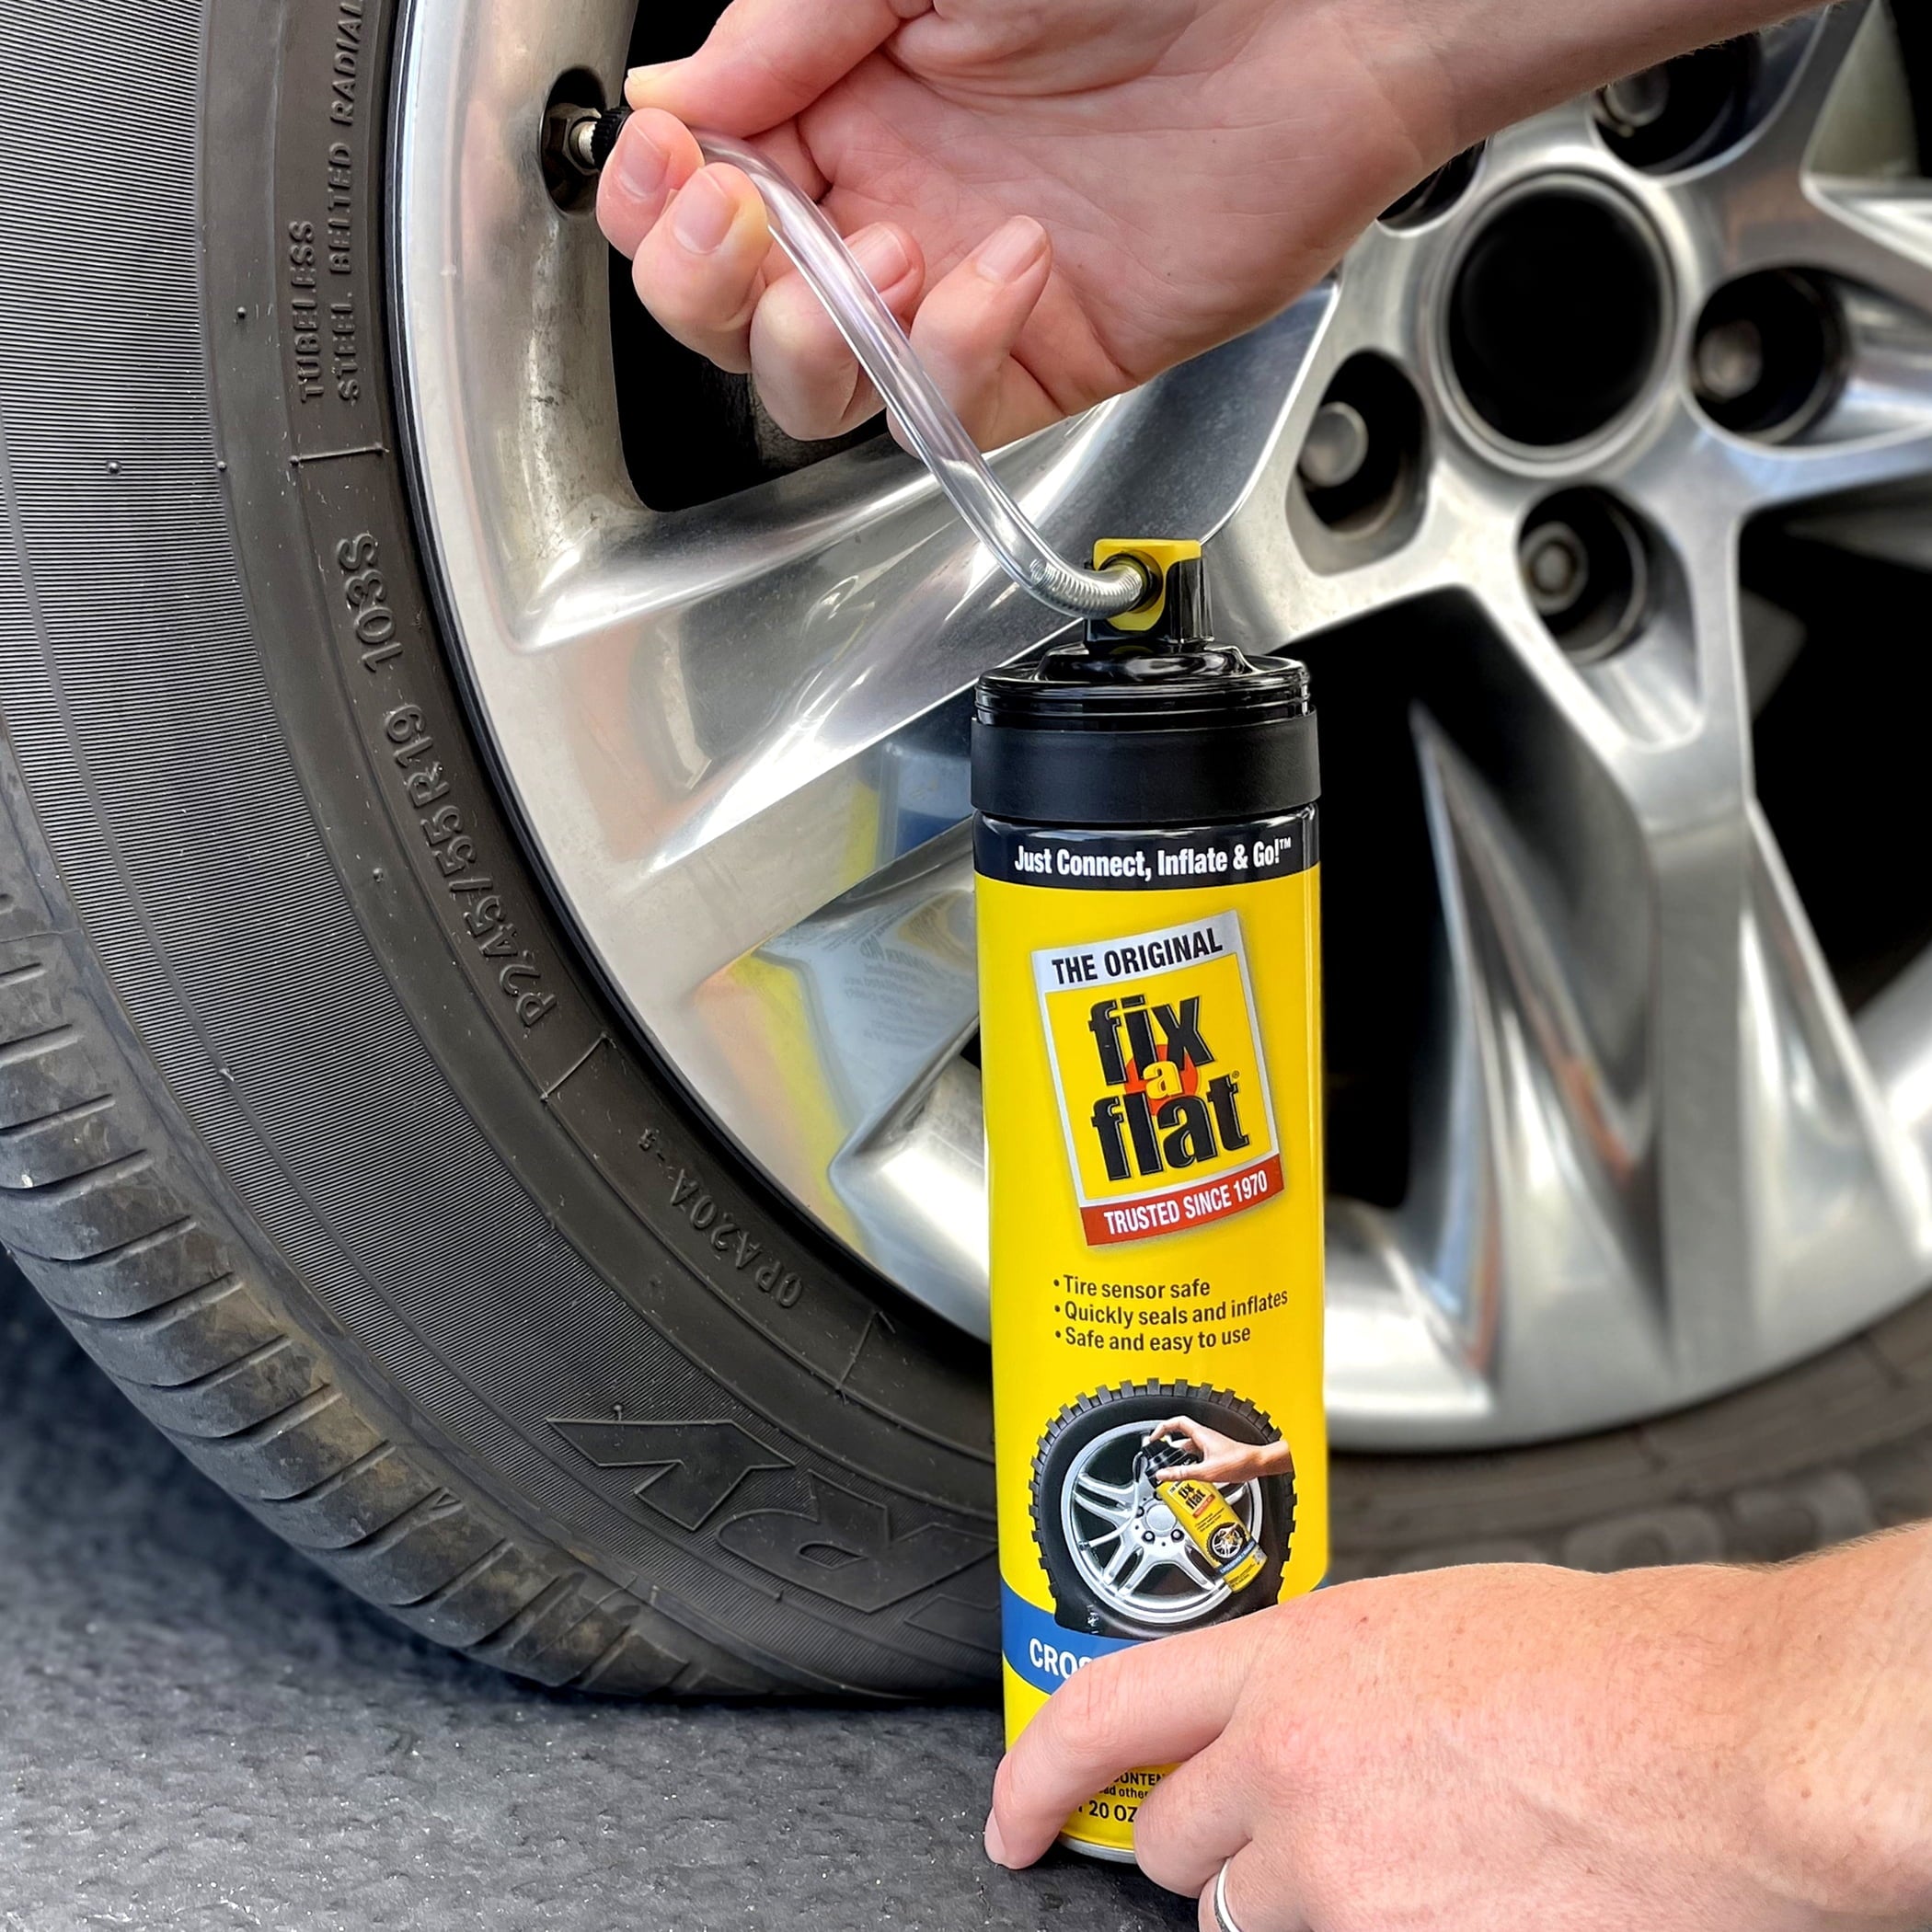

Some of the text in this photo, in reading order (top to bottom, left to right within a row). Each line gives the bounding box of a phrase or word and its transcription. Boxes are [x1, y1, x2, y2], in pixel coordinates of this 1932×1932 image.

[328, 142, 352, 274] BELTED
[289, 221, 324, 403] TUBELESS
[330, 292, 361, 403] STEEL
[1014, 845, 1052, 871] Just
[1056, 848, 1153, 882] Connect,
[1156, 845, 1228, 877] Inflate
[1232, 843, 1248, 870] &
[1052, 926, 1224, 985] THE ORIGINAL
[1087, 994, 1216, 1087] fix
[1143, 1060, 1183, 1100] a
[1103, 1168, 1269, 1236] TRUSTED SINCE 1970
[1063, 1273, 1211, 1299] Tire sensor safe
[1064, 1289, 1289, 1329] Quickly seals and inflates
[1064, 1326, 1251, 1355] Safe and easy to use
[1088, 1800, 1110, 1820] 20
